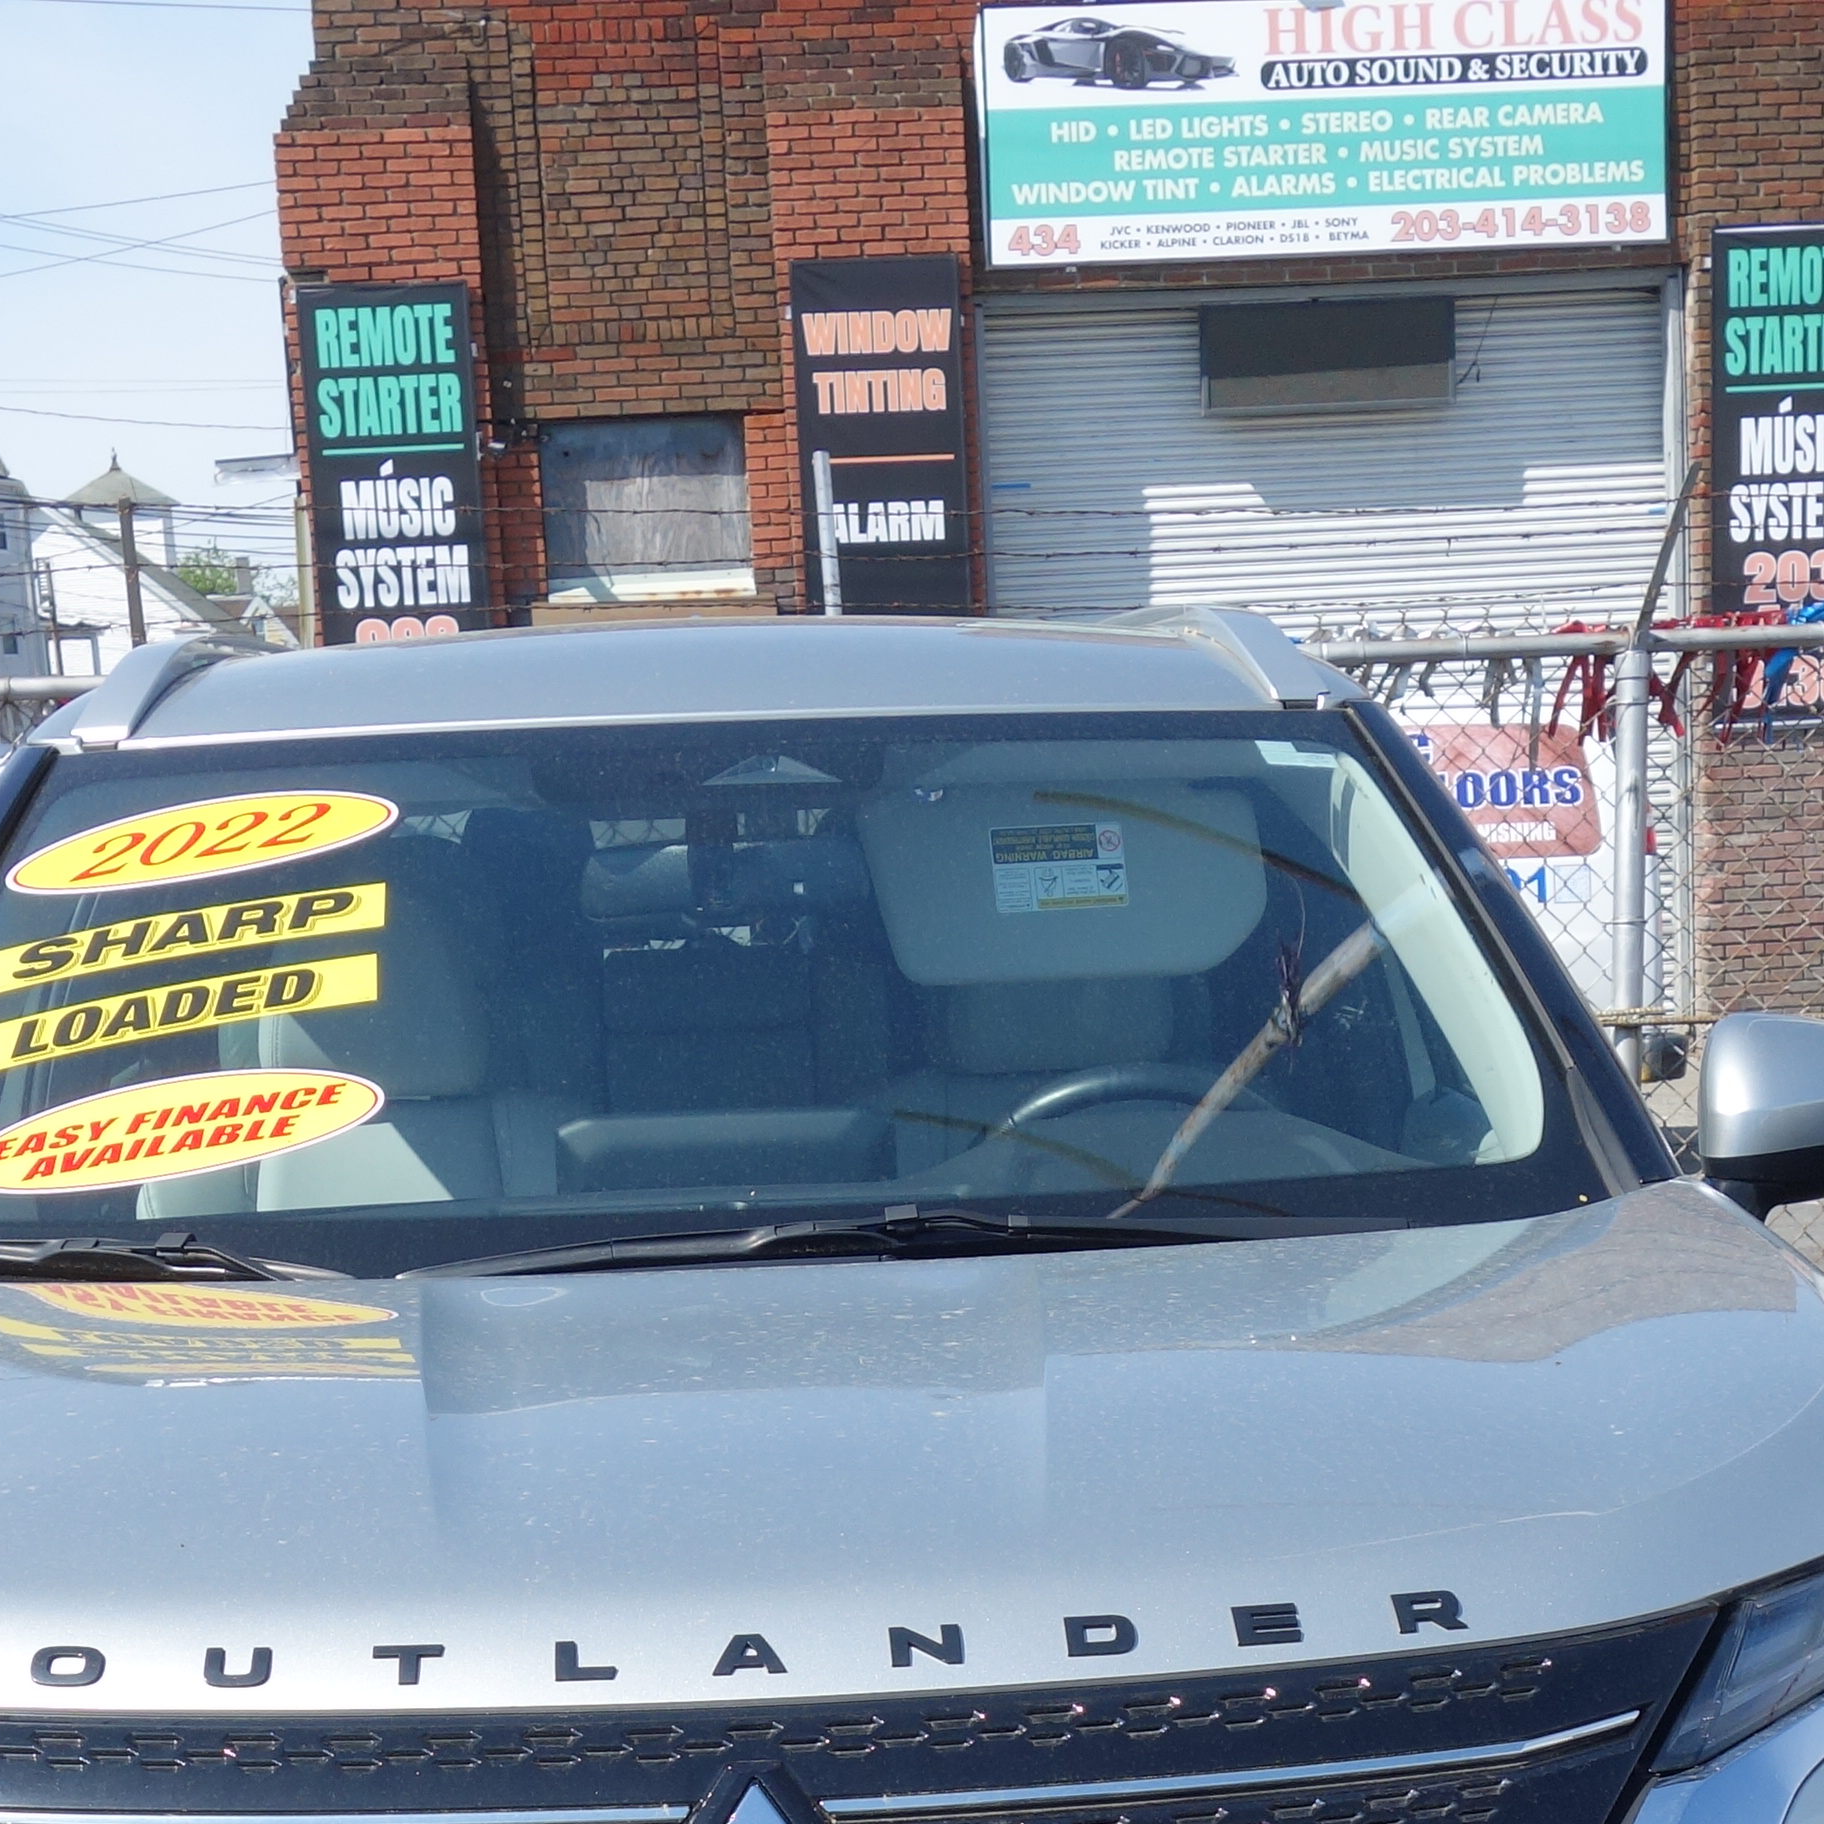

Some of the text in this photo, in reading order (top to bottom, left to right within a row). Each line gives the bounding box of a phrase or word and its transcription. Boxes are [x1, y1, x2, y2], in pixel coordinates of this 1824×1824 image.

[1263, 0, 1644, 56] HIGH CLASS
[1267, 49, 1642, 88] AUTO SOUND & SECURITY
[1050, 101, 1604, 143] HID LED LIGHTS STEREO REAR CAMERA
[1114, 134, 1544, 171] REMOTE STARTER MUSIC SYSTEM
[1011, 160, 1645, 206] WINDOW TINT ALARMS ELECTRICAL PROBLEMS
[1008, 223, 1081, 256] 434
[1100, 239, 1141, 250] KICKER
[1157, 237, 1197, 248] ALPINE
[1212, 234, 1264, 246] CLARION
[1329, 230, 1369, 241] BEYMA
[1110, 217, 1358, 236] JVC KENWOOD PIONEER JBL SONY
[1390, 201, 1651, 243] 203-414-3138
[315, 303, 456, 368] REMOTE
[801, 308, 952, 356] WINDOW
[317, 373, 463, 439] STARTER
[812, 368, 947, 414] TINTING
[335, 544, 471, 609] SYSTEM
[1439, 766, 1584, 811] OORS
[69, 802, 332, 883] 2022
[12, 891, 361, 982] SHARP
[11, 968, 323, 1061] LOADED
[125, 1082, 347, 1136] FINANCE
[22, 1114, 301, 1182] AVAILABLE
[30, 1588, 1473, 1688] OUTLANDER
